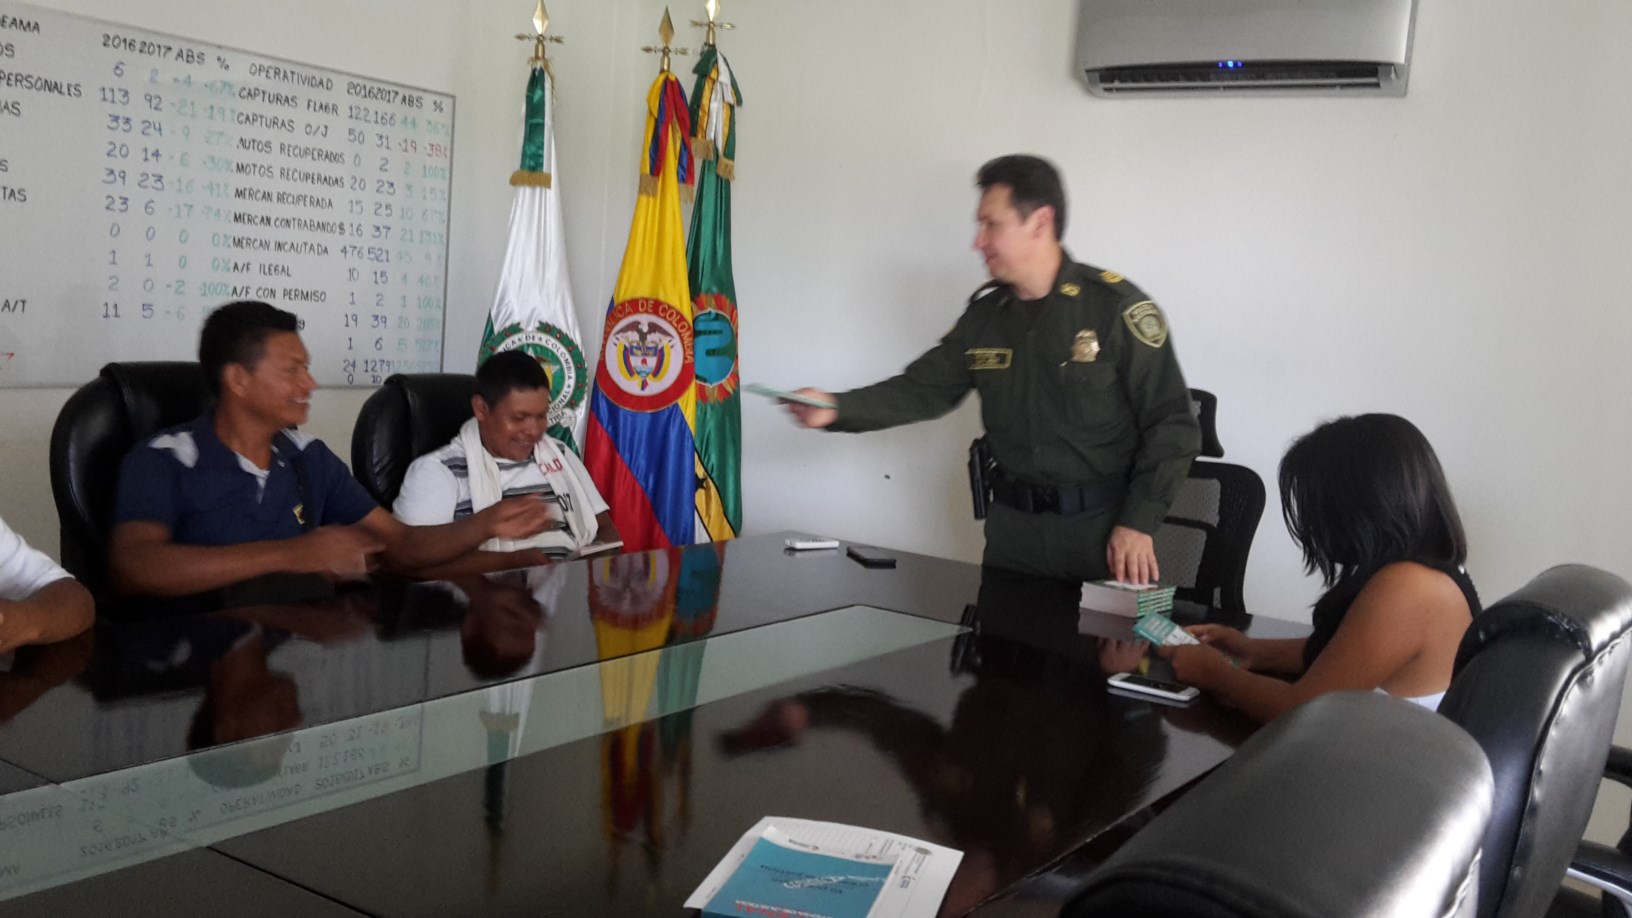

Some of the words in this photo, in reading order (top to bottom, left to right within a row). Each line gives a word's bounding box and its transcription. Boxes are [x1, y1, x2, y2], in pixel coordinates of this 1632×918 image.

[102, 34, 136, 50] 2016
[138, 41, 172, 58] 2017
[174, 49, 206, 65] ABS
[216, 56, 230, 71] %
[113, 61, 125, 78] 6
[0, 69, 82, 98] PERSONALES
[100, 86, 130, 105] 113
[144, 93, 162, 111] 92
[250, 63, 333, 91] OPERATIVIDAD
[347, 81, 375, 99] 2016
[375, 87, 399, 104] 2017
[401, 94, 423, 110] ABS
[239, 86, 297, 108] CAPTURAS
[348, 106, 371, 124] 122
[374, 110, 396, 126] 166
[106, 114, 132, 133] 33
[141, 120, 162, 137] 24
[237, 112, 294, 133] CAPTURAS
[348, 128, 364, 145] 50
[376, 134, 391, 150] 31
[106, 141, 129, 158] 20
[142, 148, 161, 163] 14
[237, 137, 272, 154] AUTOS
[280, 142, 345, 165] RECUPERADOS
[379, 157, 388, 172] 2
[102, 167, 126, 186] 39
[138, 172, 164, 191] 23
[236, 162, 274, 178] MOTOS
[280, 165, 344, 188] RECUPERADAS
[350, 176, 366, 191] 20
[376, 180, 395, 196] 23
[105, 196, 129, 212] 23
[144, 199, 155, 216] 6
[235, 187, 273, 203] MERCAN
[276, 191, 333, 210] RECUPERADA
[374, 203, 392, 217] 25
[110, 223, 120, 238] 0
[146, 226, 156, 241] 0
[234, 212, 271, 226] MERCAN
[349, 223, 363, 237] 16
[371, 225, 392, 239] 37
[232, 235, 270, 250] MERCAN
[274, 240, 328, 256] INCAUTADA
[340, 246, 364, 261] 476
[367, 247, 390, 262] 521
[108, 275, 120, 291] 2
[143, 278, 154, 293] 0
[233, 262, 251, 275] A/F
[259, 264, 292, 278] ILEGAL
[348, 268, 359, 282] 10
[373, 271, 388, 285] 15
[231, 286, 251, 298] A/F
[256, 286, 276, 300] CON
[283, 288, 326, 303] PERMISO
[376, 293, 384, 307] 2
[102, 302, 121, 319] 11
[142, 303, 154, 320] 5
[345, 313, 358, 328] 19
[371, 314, 387, 329] 39
[638, 299, 654, 312] DE
[659, 304, 693, 364] COLOMBIA
[375, 337, 383, 351] 6
[343, 359, 356, 373] 24
